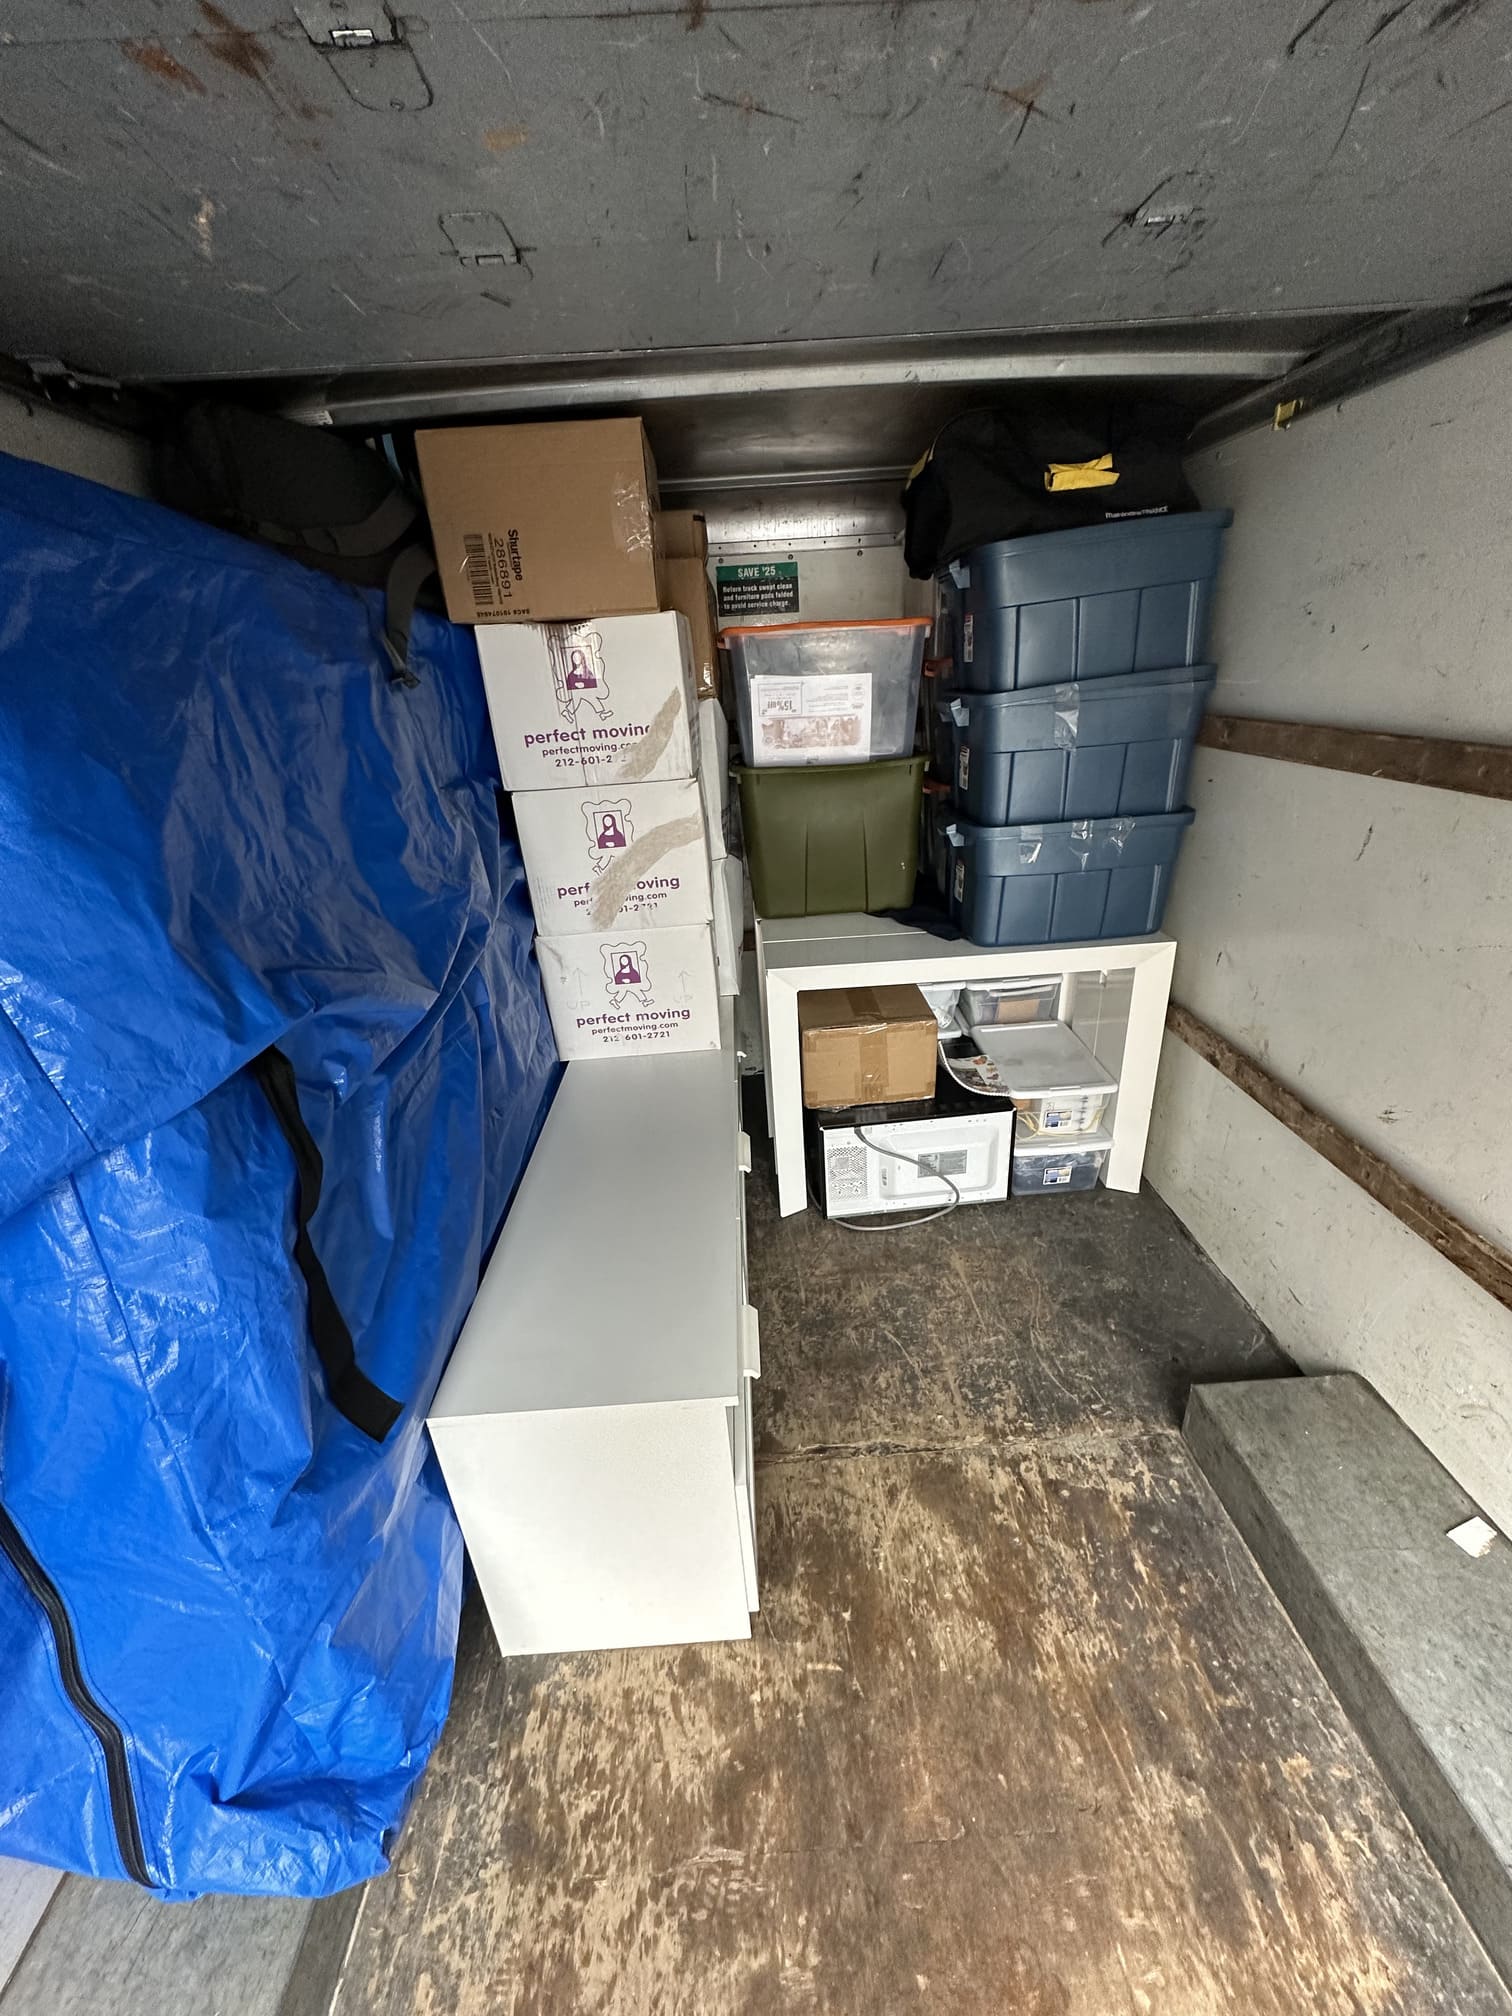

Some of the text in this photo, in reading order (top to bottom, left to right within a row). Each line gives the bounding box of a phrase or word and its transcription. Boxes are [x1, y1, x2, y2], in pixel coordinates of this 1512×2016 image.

[507, 528, 523, 581] Shurtape
[494, 538, 512, 598] 286891
[737, 567, 760, 577] SAVE
[723, 602, 730, 610] to
[747, 600, 769, 608] service
[735, 592, 760, 600] furniture
[775, 590, 794, 599] folded
[523, 728, 587, 748] perfect
[556, 876, 681, 900] perf oving
[576, 1007, 691, 1029] perfect moving
[591, 1020, 679, 1036] perfectmoving.com
